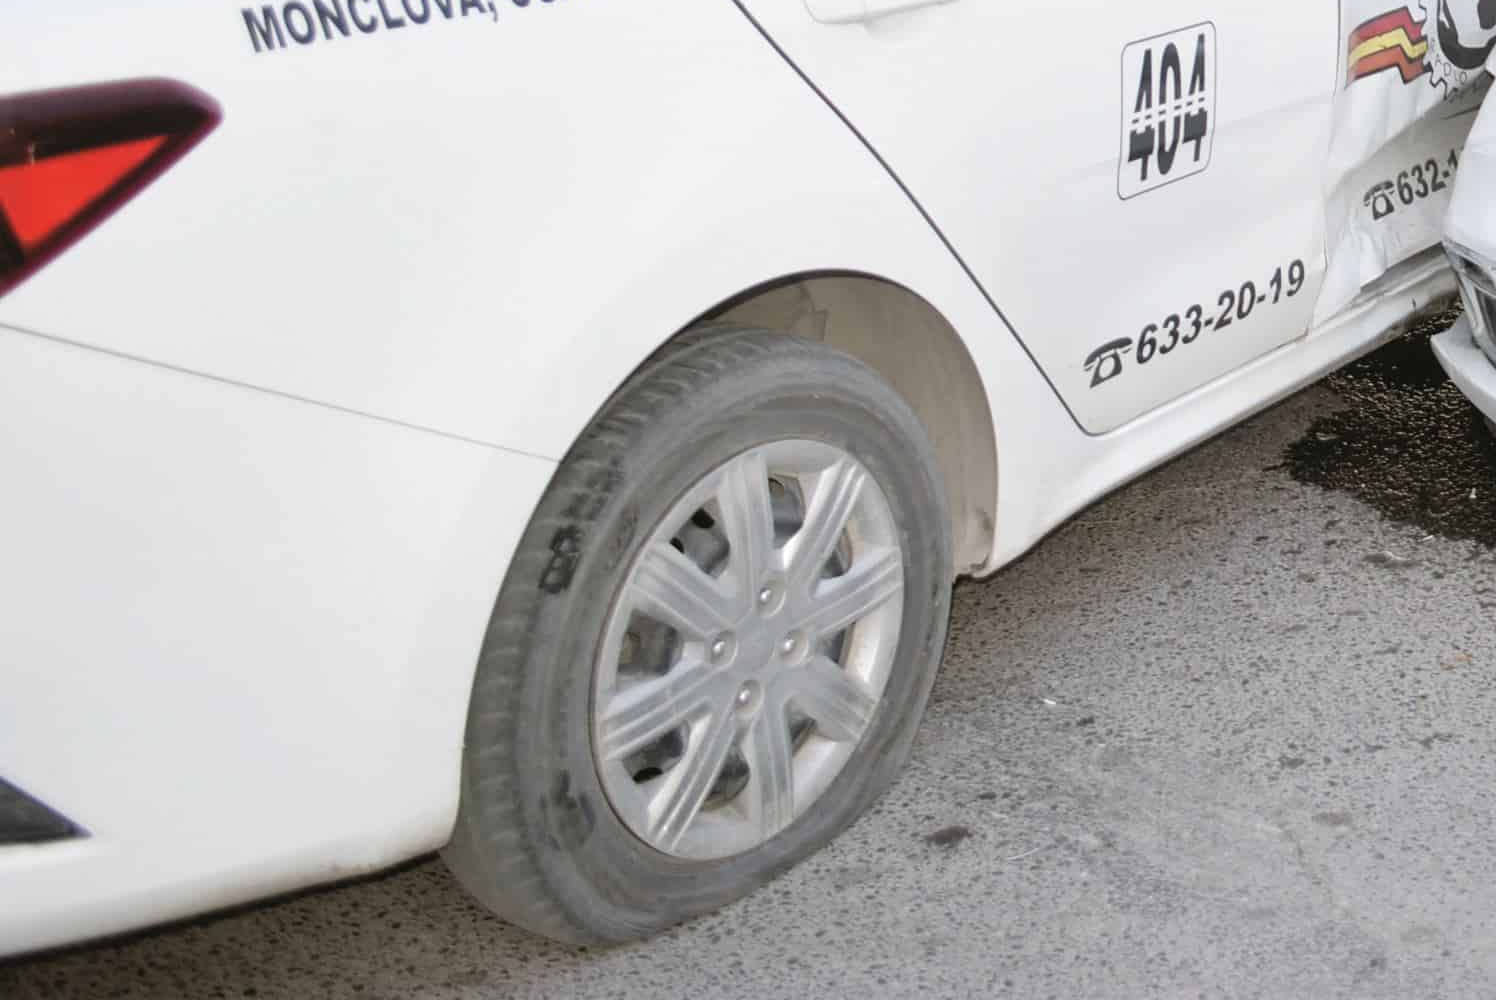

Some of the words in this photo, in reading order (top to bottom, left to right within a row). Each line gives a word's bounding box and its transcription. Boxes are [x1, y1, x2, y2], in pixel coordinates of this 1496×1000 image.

[1127, 33, 1209, 182] 404
[1396, 148, 1465, 206] 632-1
[1136, 258, 1306, 366] 633-20-19
